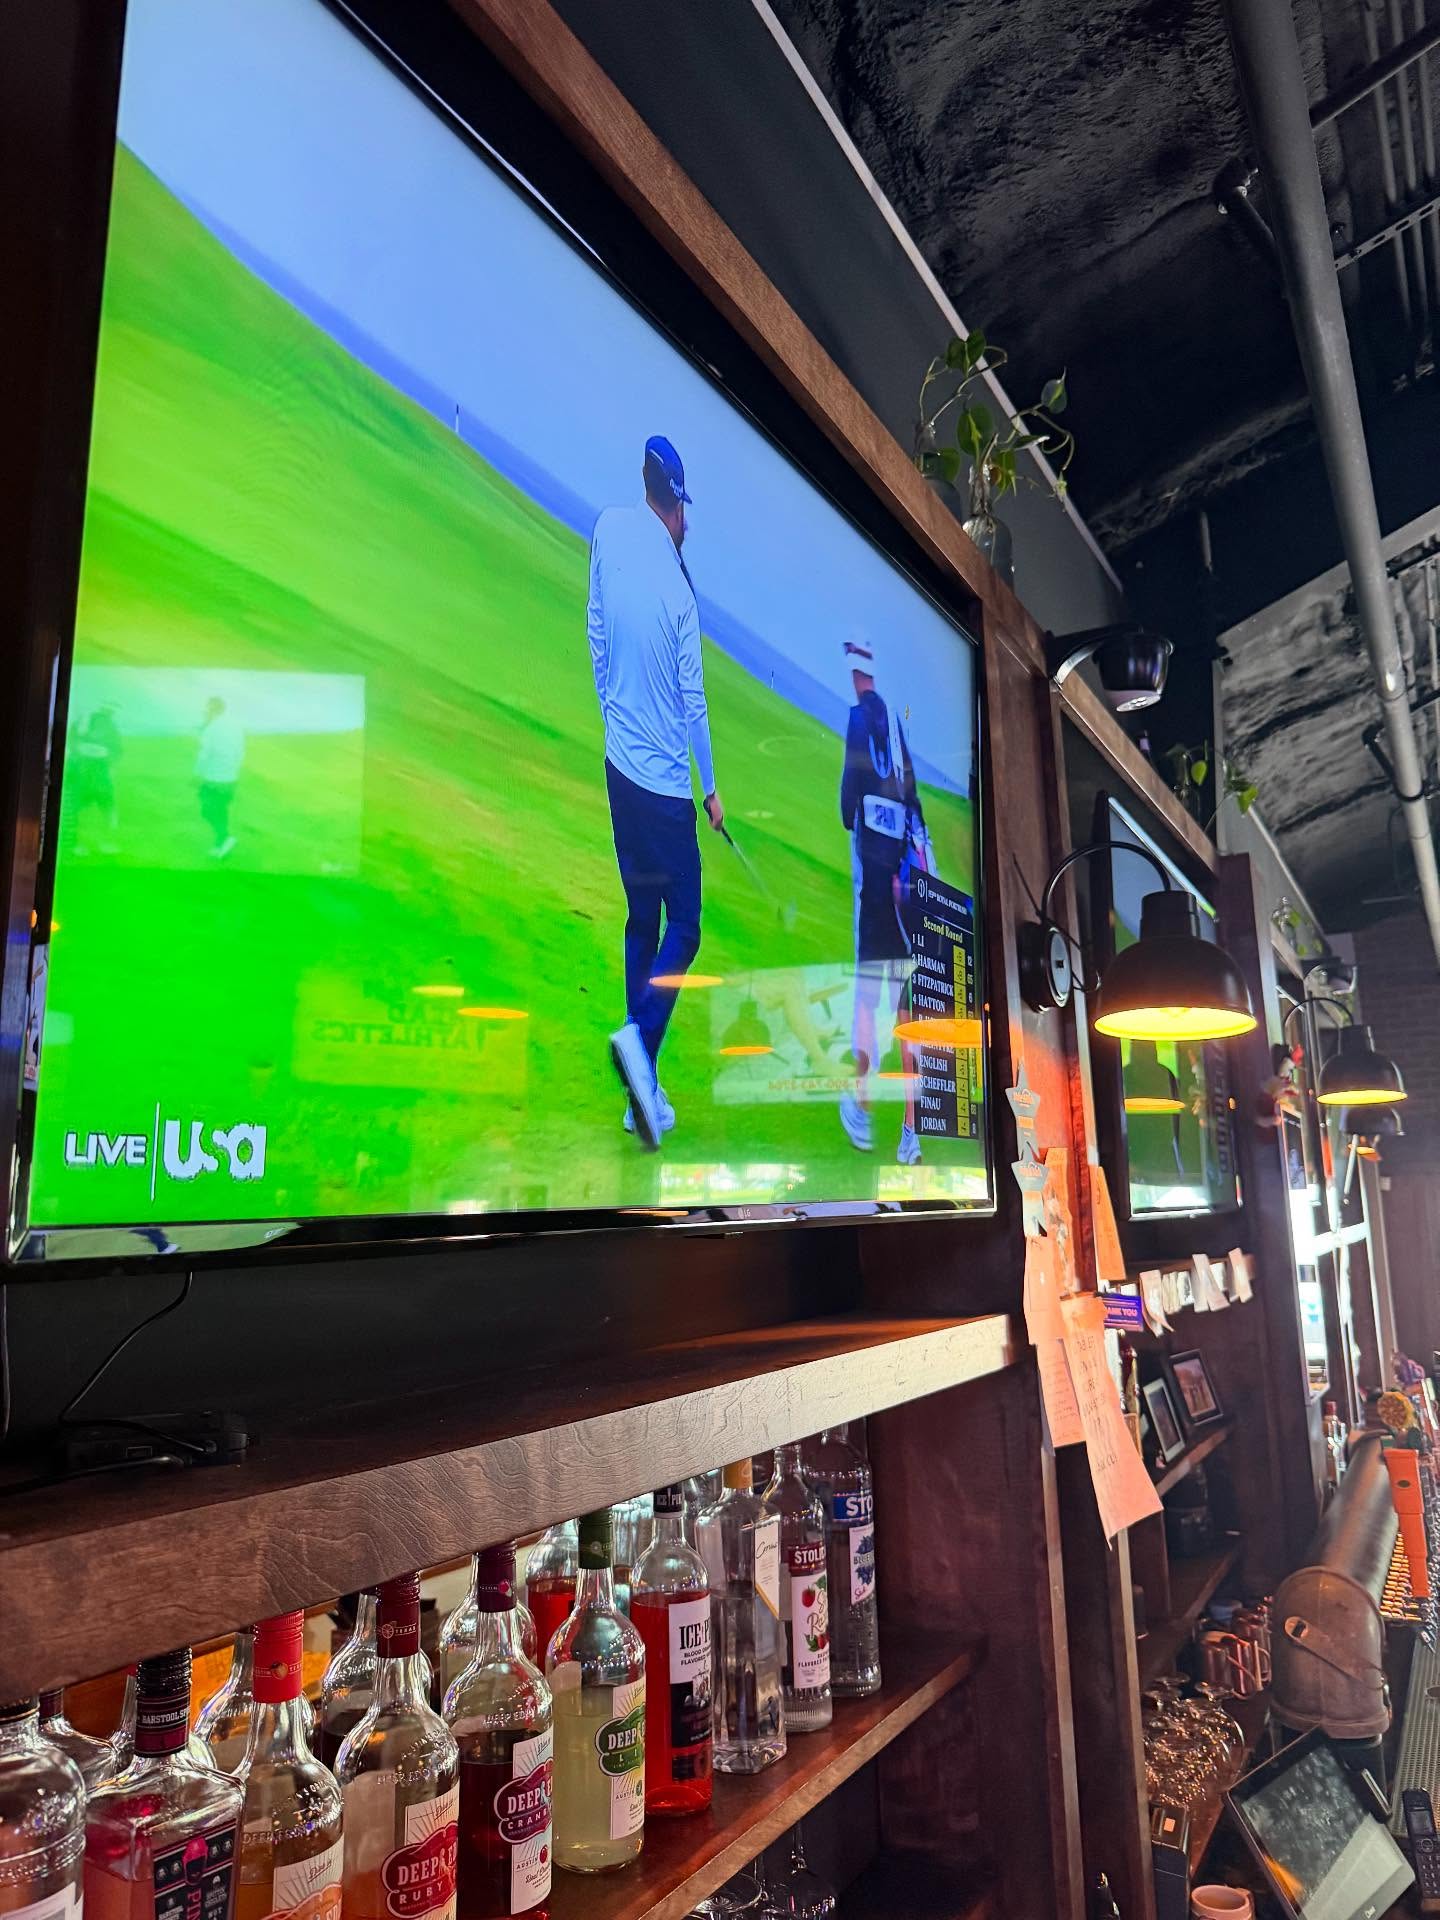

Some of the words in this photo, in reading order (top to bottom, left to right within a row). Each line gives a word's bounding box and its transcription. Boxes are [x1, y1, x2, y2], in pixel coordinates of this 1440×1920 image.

[923, 916, 945, 936] Second
[945, 924, 963, 944] Round
[917, 933, 925, 948] LI
[917, 953, 946, 975] HARMAN
[917, 972, 954, 997] FITZPATRICK
[918, 993, 946, 1013] HATTON
[919, 1054, 948, 1073] ENGLISH
[919, 1074, 956, 1093] SCHEFFLER
[920, 1095, 941, 1111] FINAU
[920, 1116, 947, 1132] JORDAN
[64, 1131, 147, 1170] LIVE
[1122, 1308, 1138, 1317] YOU
[395, 1624, 417, 1635] TEXAS
[679, 1622, 702, 1650] ICE
[680, 1654, 706, 1666] FLAVORED
[683, 1649, 702, 1658] BLOOD
[142, 1711, 180, 1725] BARSTOOL
[607, 1727, 638, 1751] DEEP
[507, 1786, 543, 1815] DEEP
[397, 1856, 439, 1886] DEEP
[516, 1857, 539, 1870] AUSTIN
[399, 1880, 443, 1905] RUBY
